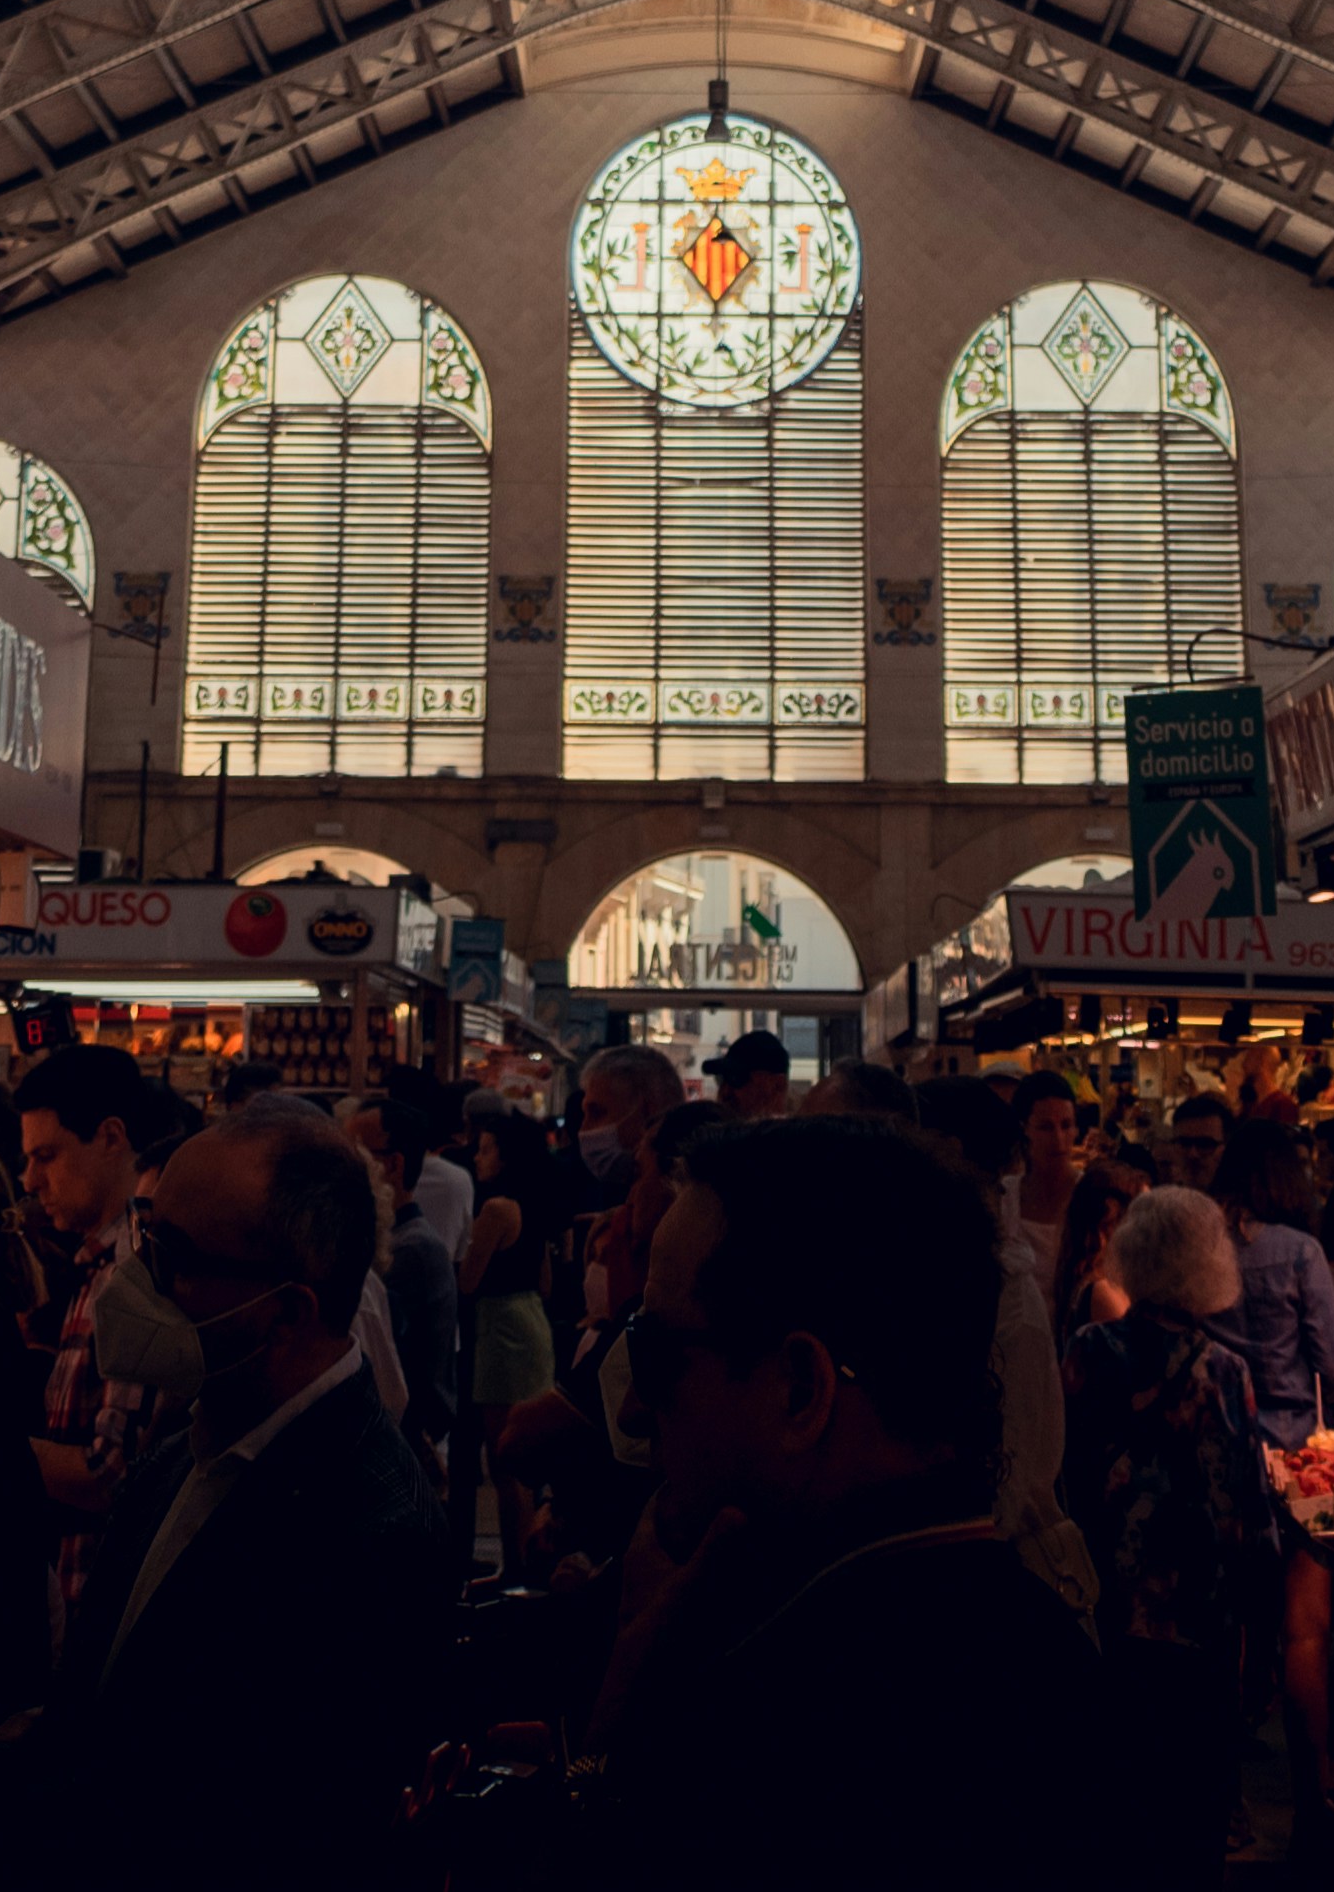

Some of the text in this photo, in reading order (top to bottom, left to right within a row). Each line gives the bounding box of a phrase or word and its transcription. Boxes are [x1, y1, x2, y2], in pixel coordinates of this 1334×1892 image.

[1134, 711, 1255, 745] Servicio a
[1139, 744, 1255, 778] domicilio
[39, 891, 172, 927] QUESO
[1020, 906, 1275, 962] VIRGINIA
